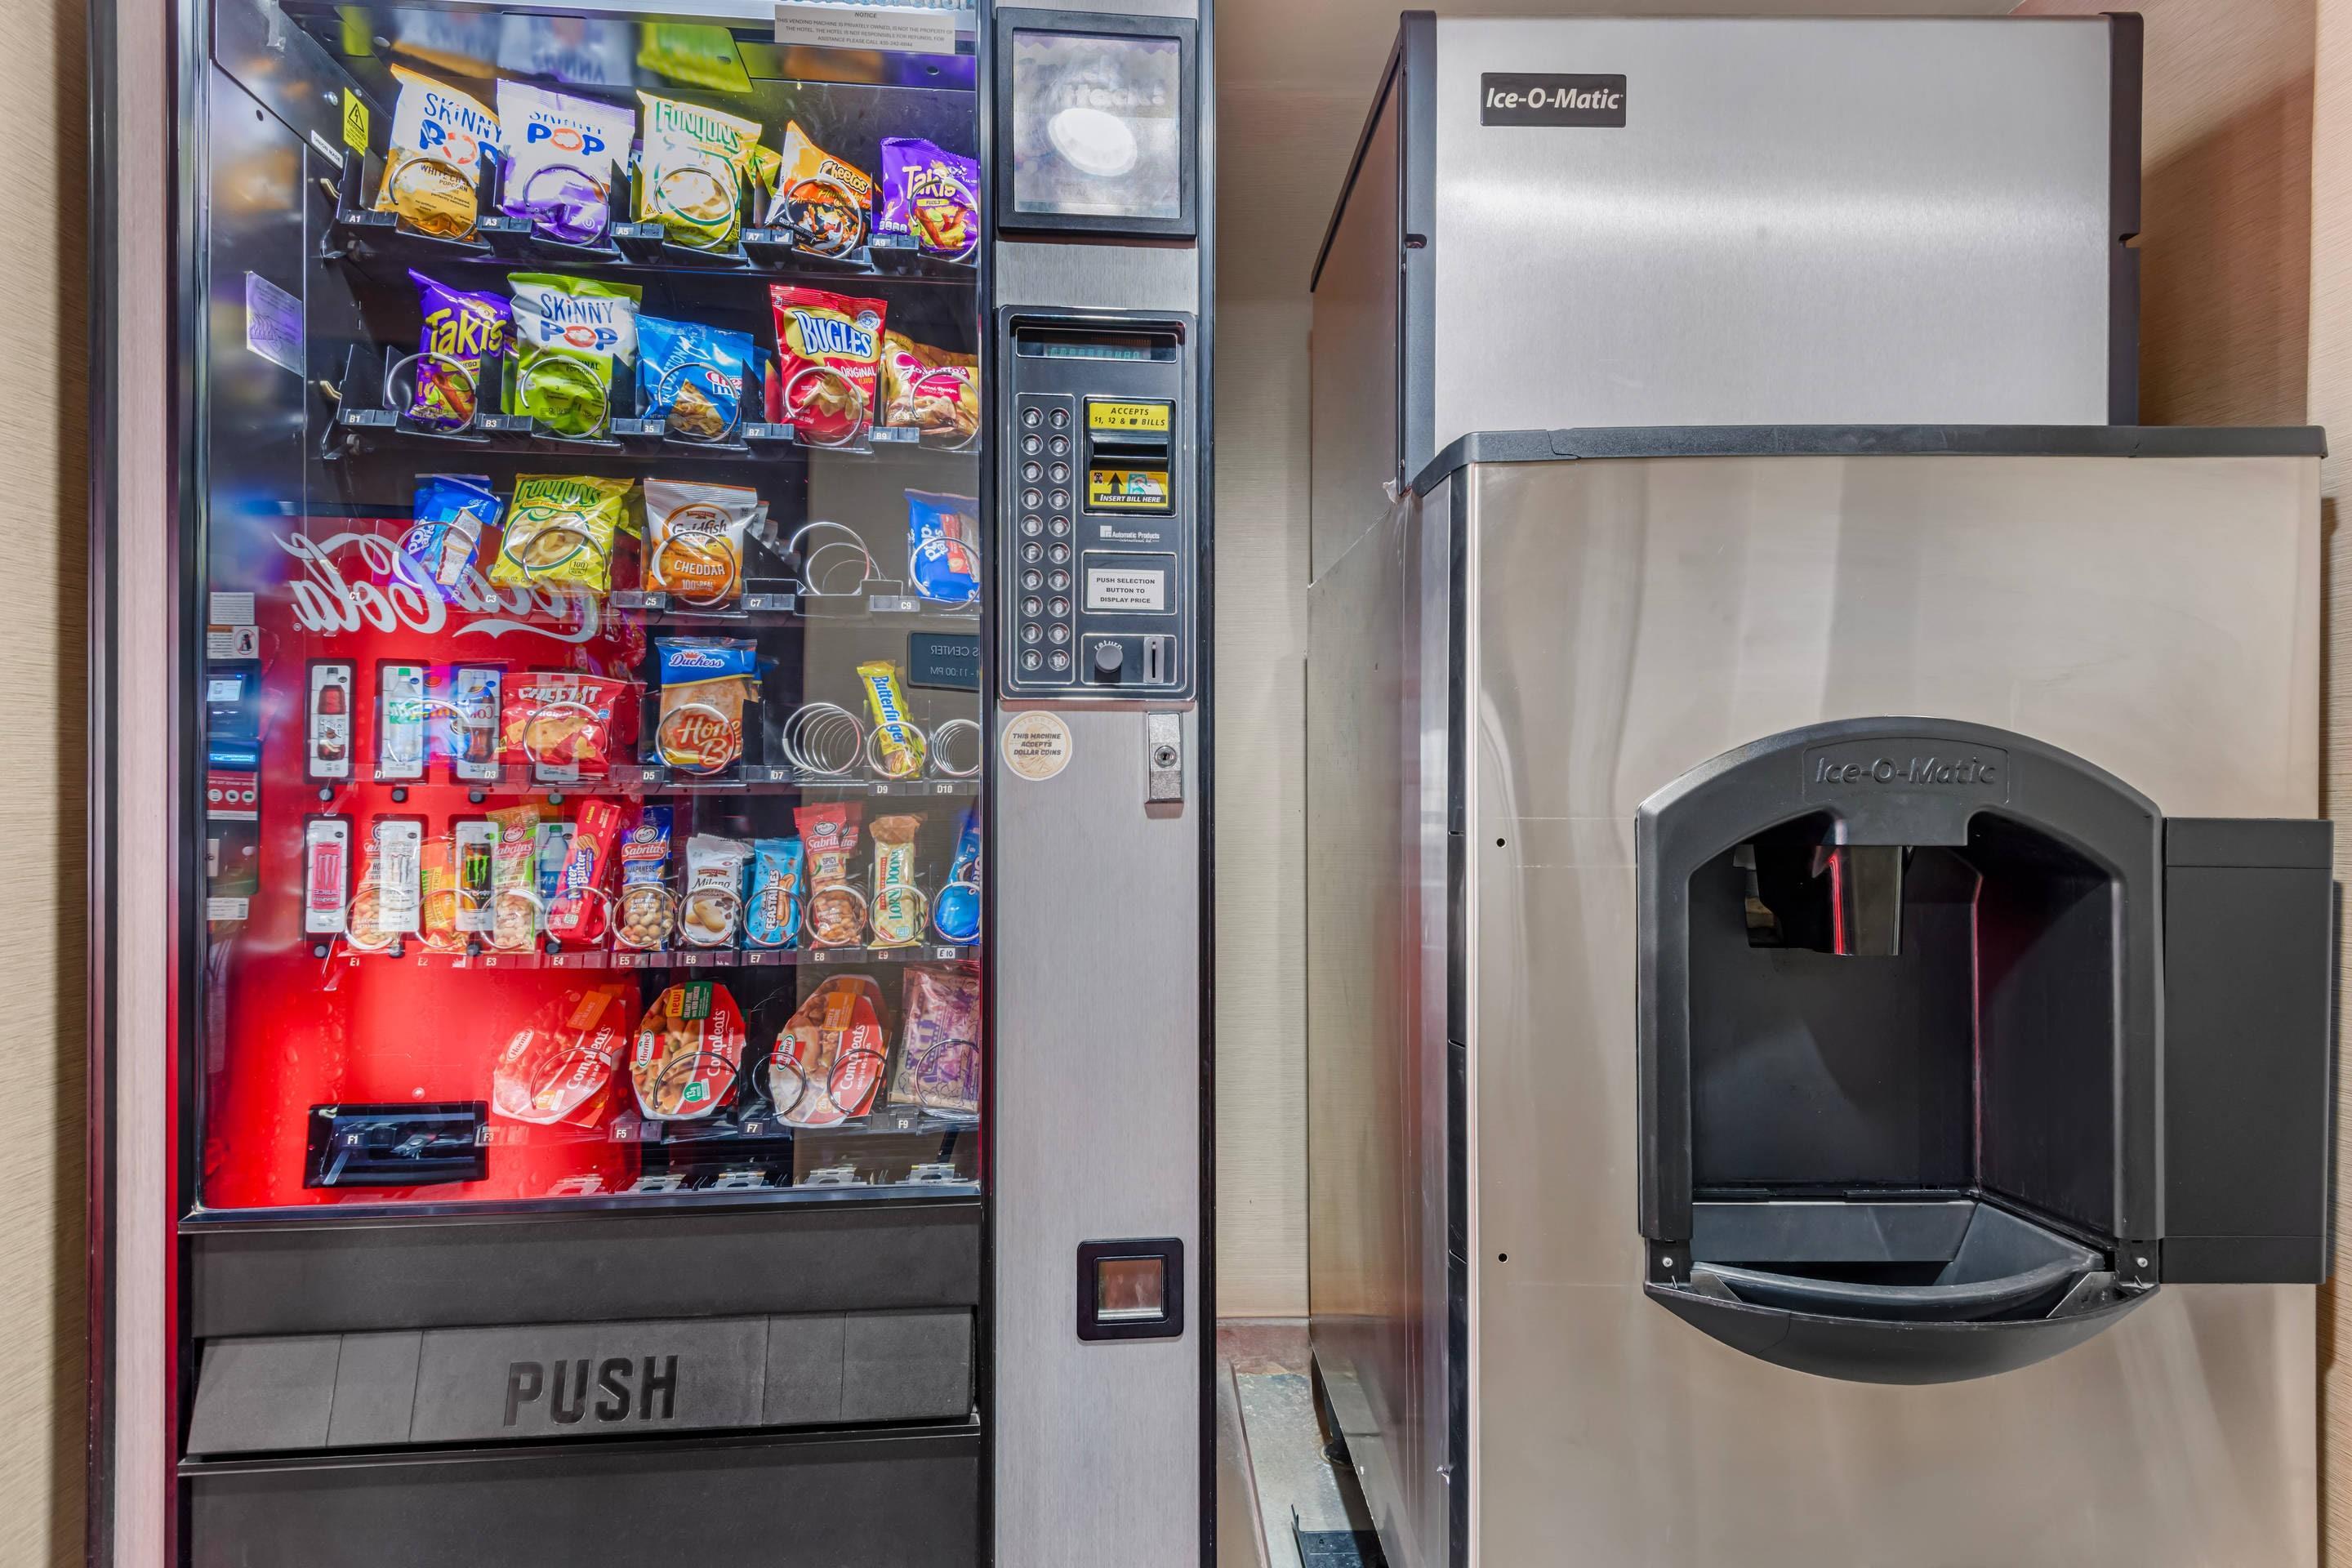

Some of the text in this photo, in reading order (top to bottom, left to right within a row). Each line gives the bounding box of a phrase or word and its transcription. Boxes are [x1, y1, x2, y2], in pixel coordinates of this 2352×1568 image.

[861, 31, 896, 39] RESPONSIBLE
[1486, 87, 1619, 110] Ice-O-Matic
[424, 92, 502, 143] SKINNY
[655, 100, 742, 154] FUNYUNS
[527, 122, 606, 156] POP
[328, 149, 341, 163] MADE
[819, 159, 869, 194] Cheetos
[902, 165, 956, 200] Takis
[349, 215, 360, 223] A1
[485, 218, 497, 226] A3
[617, 226, 629, 235] A5
[540, 292, 614, 324] SKINNY
[425, 307, 507, 364] Takis
[540, 319, 618, 351] POP
[791, 310, 872, 359] BUGLES
[840, 364, 876, 377] ORIGINAL
[1111, 407, 1149, 416] ACCEPTS
[349, 414, 360, 423] B1
[485, 419, 497, 427] B3
[1107, 416, 1116, 425] $2
[1142, 418, 1165, 426] BILLS
[514, 479, 602, 507] FUNYUNS
[1100, 493, 1160, 504] INSERT BILL HERE
[1111, 531, 1160, 540] Automatic Products
[572, 560, 586, 568] 100
[674, 559, 726, 576] CHEDDAR
[348, 591, 361, 600] C1
[485, 595, 497, 603] C3
[645, 598, 657, 606] C5
[750, 599, 761, 607] C7
[901, 601, 912, 609] C9
[1094, 639, 1123, 651] return
[668, 652, 724, 668] Duchess
[374, 770, 385, 779] D1
[483, 770, 497, 779] D3
[1815, 756, 1998, 785] Ice-O-Matic
[643, 772, 655, 780] D5
[876, 785, 888, 794] D9
[937, 785, 953, 794] D10
[622, 844, 666, 857] Sabritas
[822, 856, 836, 865] SPICY
[577, 850, 587, 884] Butter
[628, 865, 656, 873] JAPANESE
[691, 877, 732, 889] Milano
[686, 955, 697, 964] E6
[751, 954, 761, 963] E7
[814, 952, 825, 961] E8
[878, 951, 889, 960] E9
[350, 957, 360, 966] E1
[417, 957, 428, 966] E2
[486, 957, 497, 966] E3
[553, 956, 564, 965] E4
[619, 956, 630, 965] E5
[671, 990, 682, 1014] new!
[510, 1029, 531, 1058] Hormel
[706, 1009, 728, 1077] Compleats
[639, 1034, 651, 1062] Hormel
[566, 1025, 611, 1089] Compleats
[840, 1024, 866, 1090] Compleats
[686, 1086, 697, 1099] 13g
[746, 1124, 758, 1133] F7
[898, 1120, 909, 1129] F9
[483, 1133, 494, 1142] F3
[616, 1129, 627, 1138] F5
[347, 1134, 359, 1144] F1
[503, 1354, 679, 1428] PUSH
